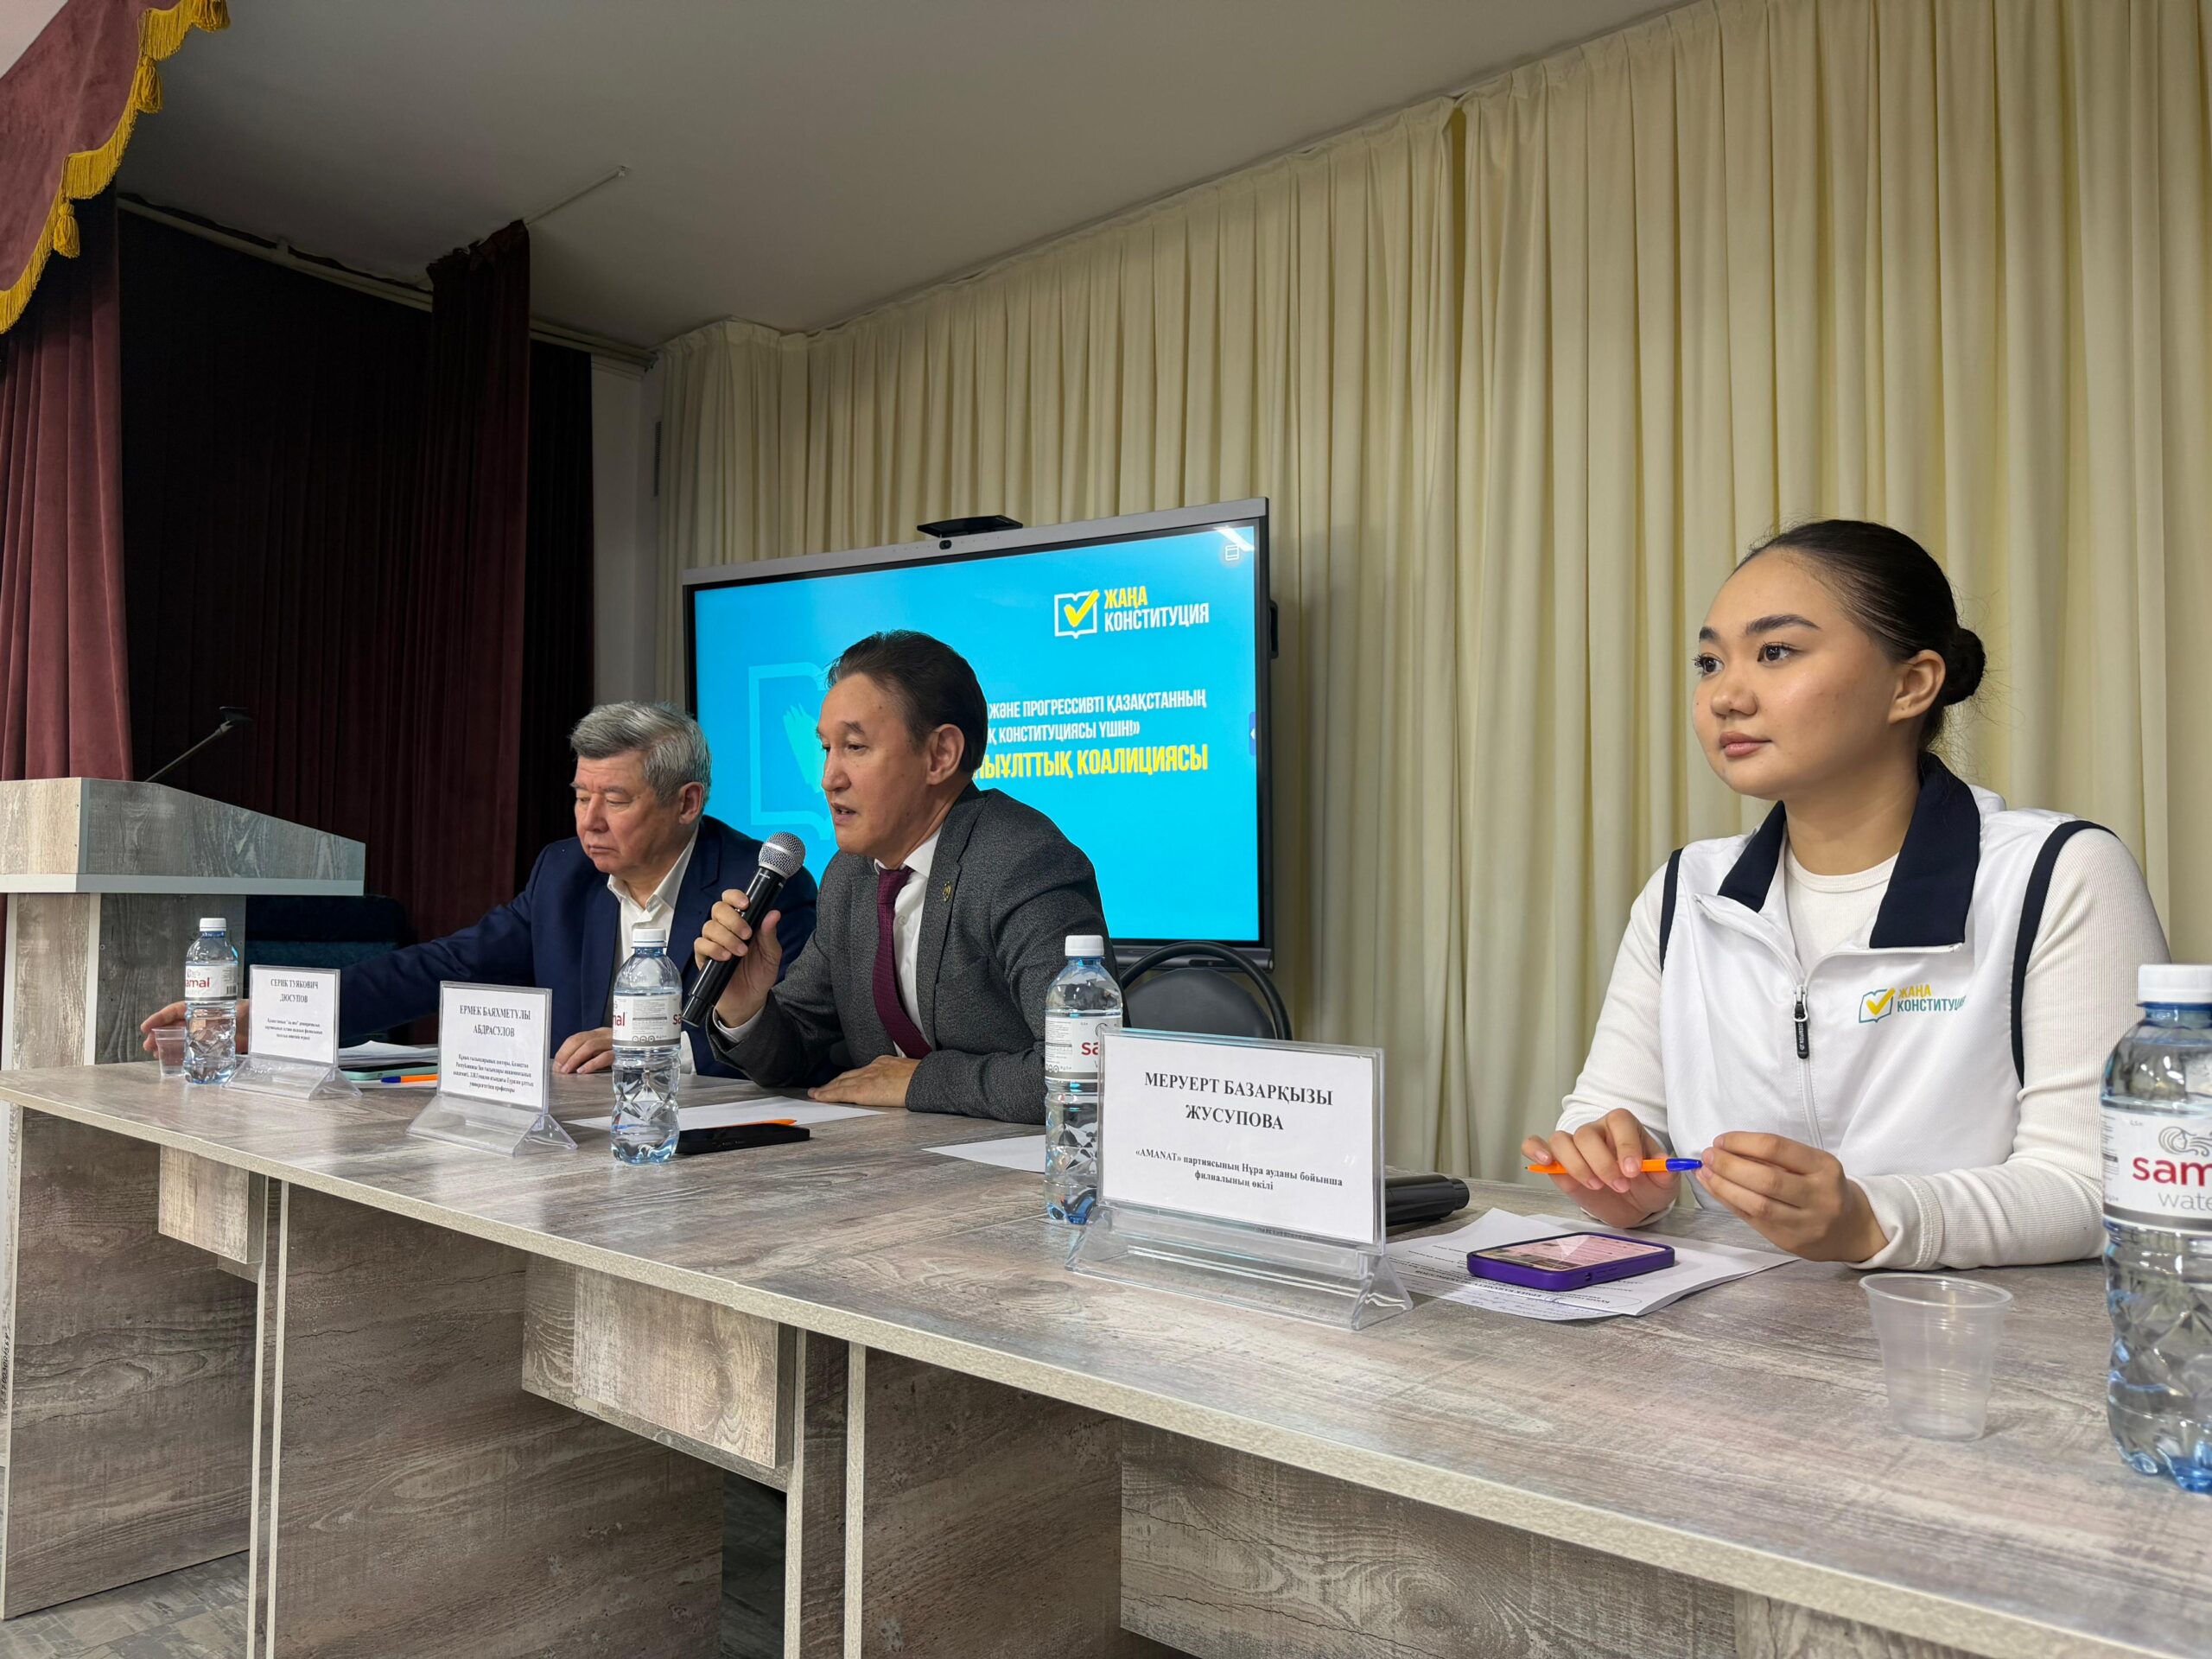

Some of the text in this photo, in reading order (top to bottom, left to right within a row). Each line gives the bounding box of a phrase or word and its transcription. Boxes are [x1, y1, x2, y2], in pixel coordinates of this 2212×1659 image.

[1104, 586, 1148, 608] ЖАҢА
[1104, 602, 1210, 632] КОНСТИТУЦИЯ
[988, 689, 1207, 719] ЖӘНЕ ПРОГРЕССИВТІ ҚАЗАҚСТАННЫҢ
[999, 721, 1096, 744] КОНСТИТУЦИЯСЫ
[1077, 743, 1209, 776] КОАЛИЦИЯСЫ
[1898, 983, 1932, 999] ЖАҢА
[460, 1004, 482, 1015] ЕРМЕК
[474, 1024, 515, 1037] АБДРАСУЛОВ
[1144, 1071, 1334, 1106] МЕРУЕРТ БАЗАРҚЫЗЫ
[1185, 1103, 1285, 1131] ЖУСУПОВА
[1135, 1147, 1344, 1187] «AMANAT» партиясының Нұра ауданы бойынша
[2132, 1156, 2212, 1187] sam
[1194, 1169, 1274, 1191] филиалының өкілі
[2158, 1192, 2212, 1211] wate
